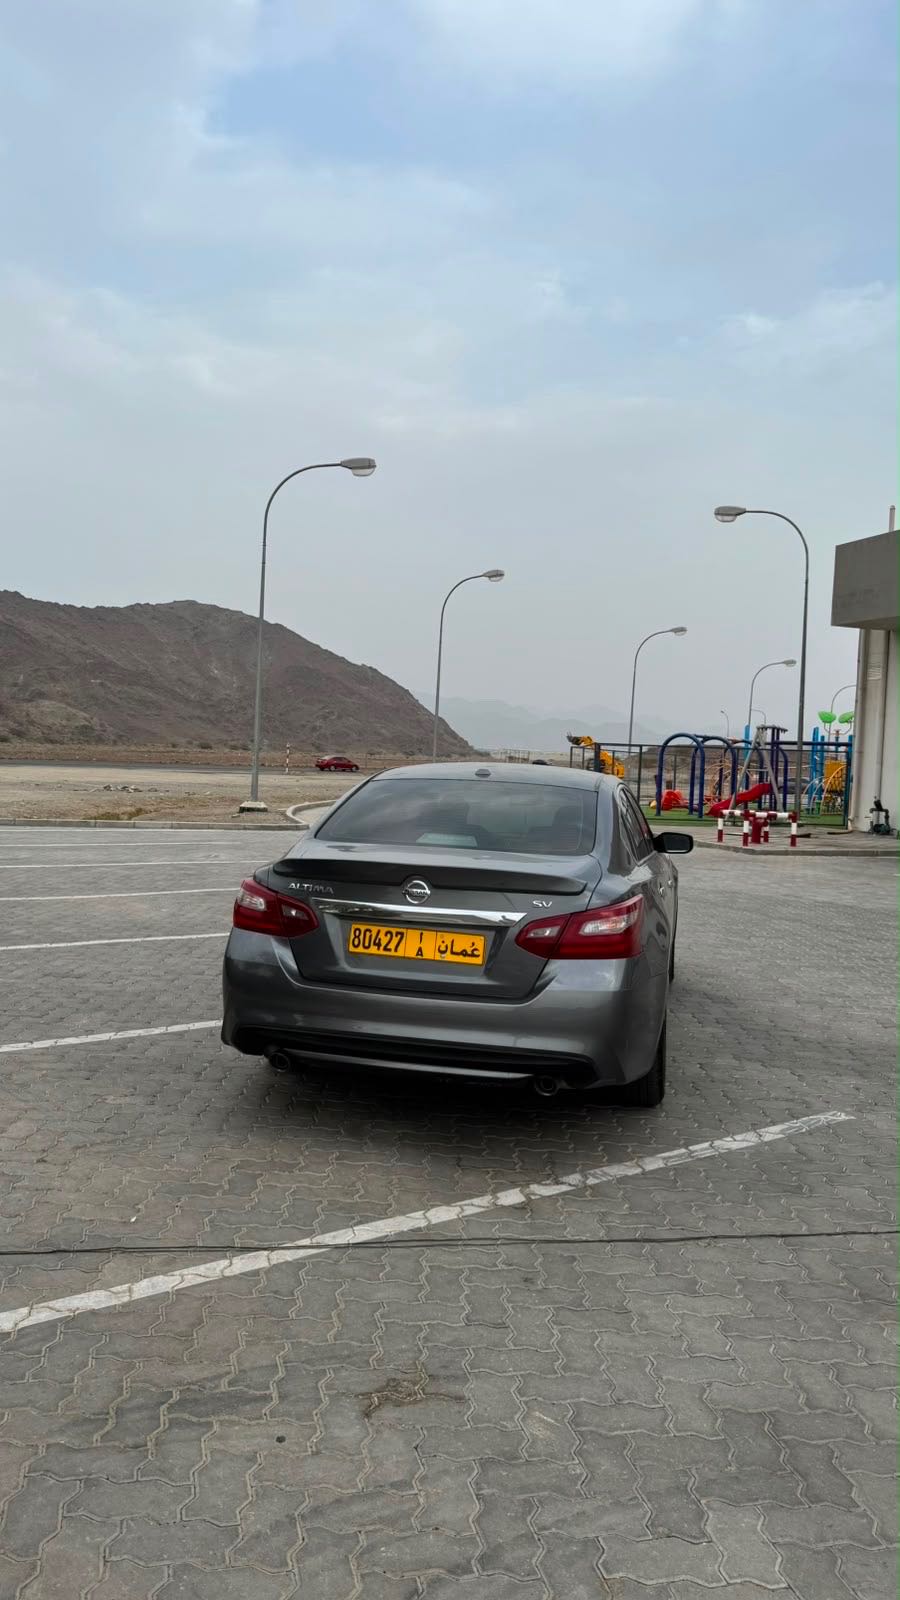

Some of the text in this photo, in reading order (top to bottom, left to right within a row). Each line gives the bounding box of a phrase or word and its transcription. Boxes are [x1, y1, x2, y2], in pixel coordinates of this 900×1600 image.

[288, 882, 335, 894] ALTIMA
[532, 900, 553, 908] SV
[351, 927, 405, 953] 80427
[415, 946, 424, 957] A
